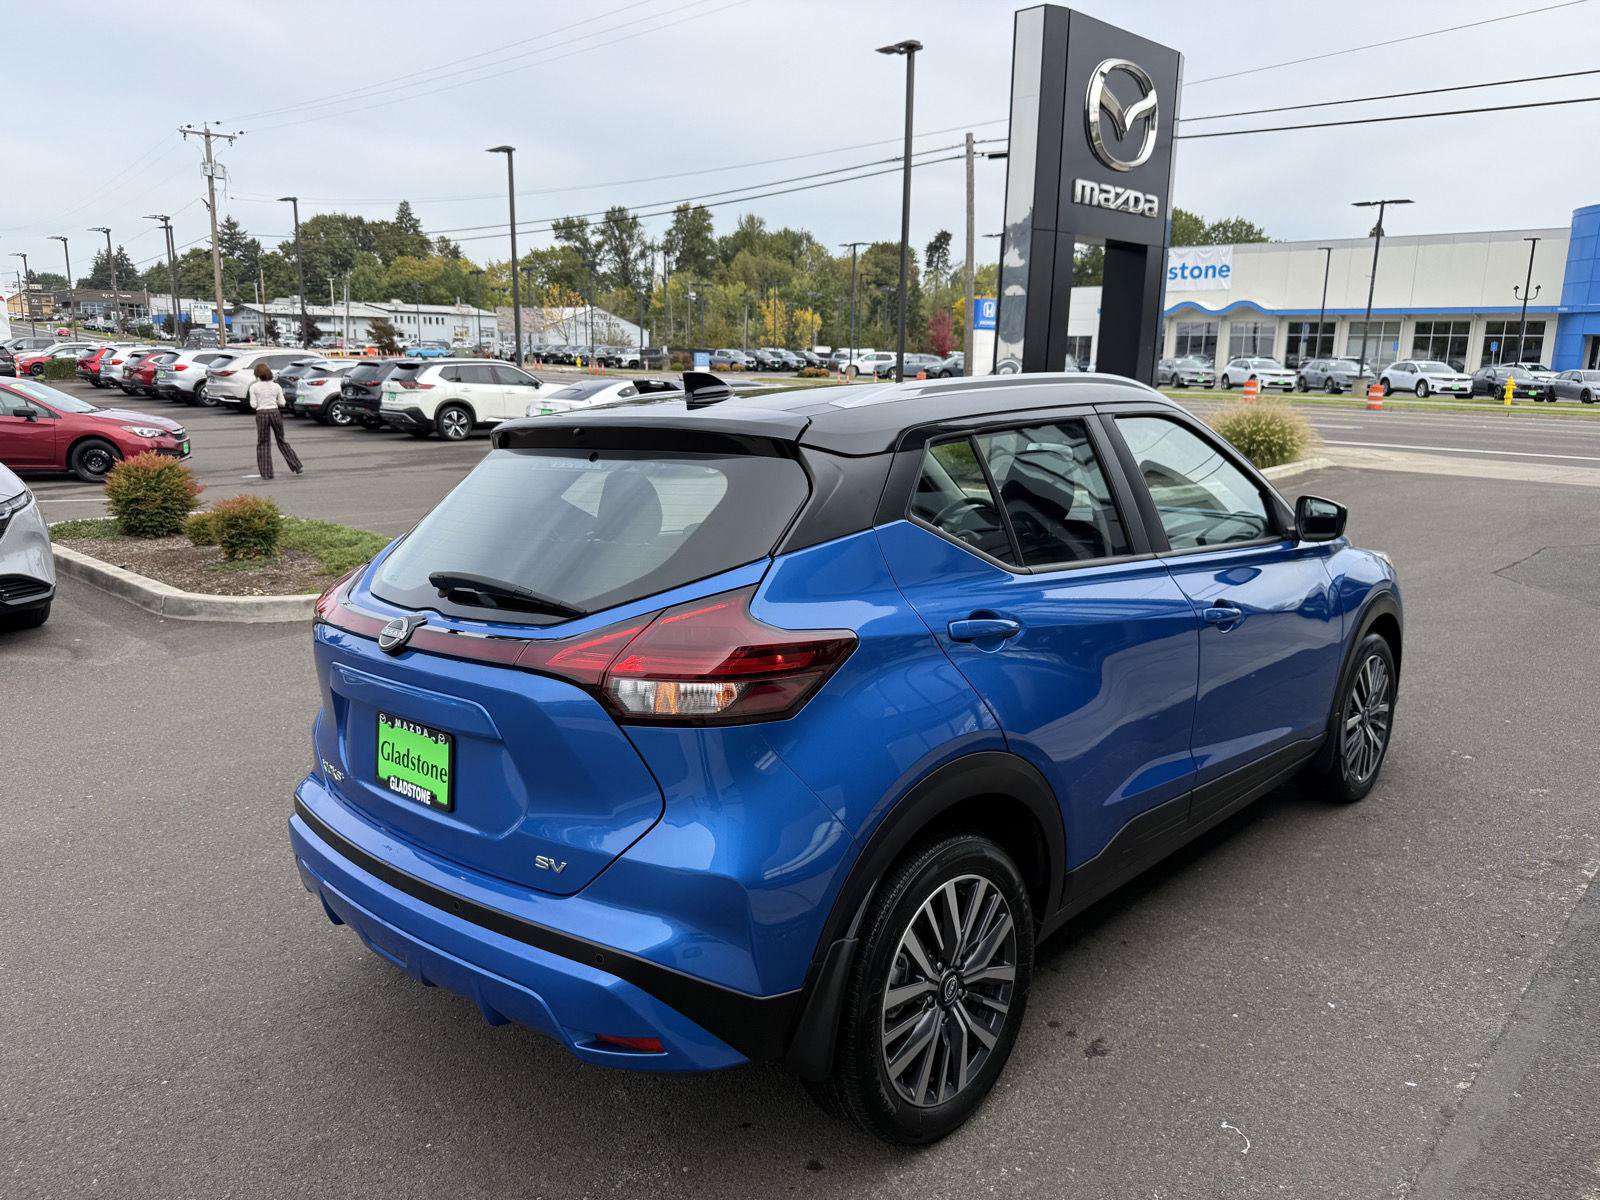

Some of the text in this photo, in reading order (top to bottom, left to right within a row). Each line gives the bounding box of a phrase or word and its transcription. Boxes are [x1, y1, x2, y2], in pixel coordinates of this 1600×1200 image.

[394, 718, 429, 738] MAZDA
[381, 741, 448, 783] Gladstone
[389, 776, 432, 805] GLADSTONE
[535, 855, 567, 874] SV
